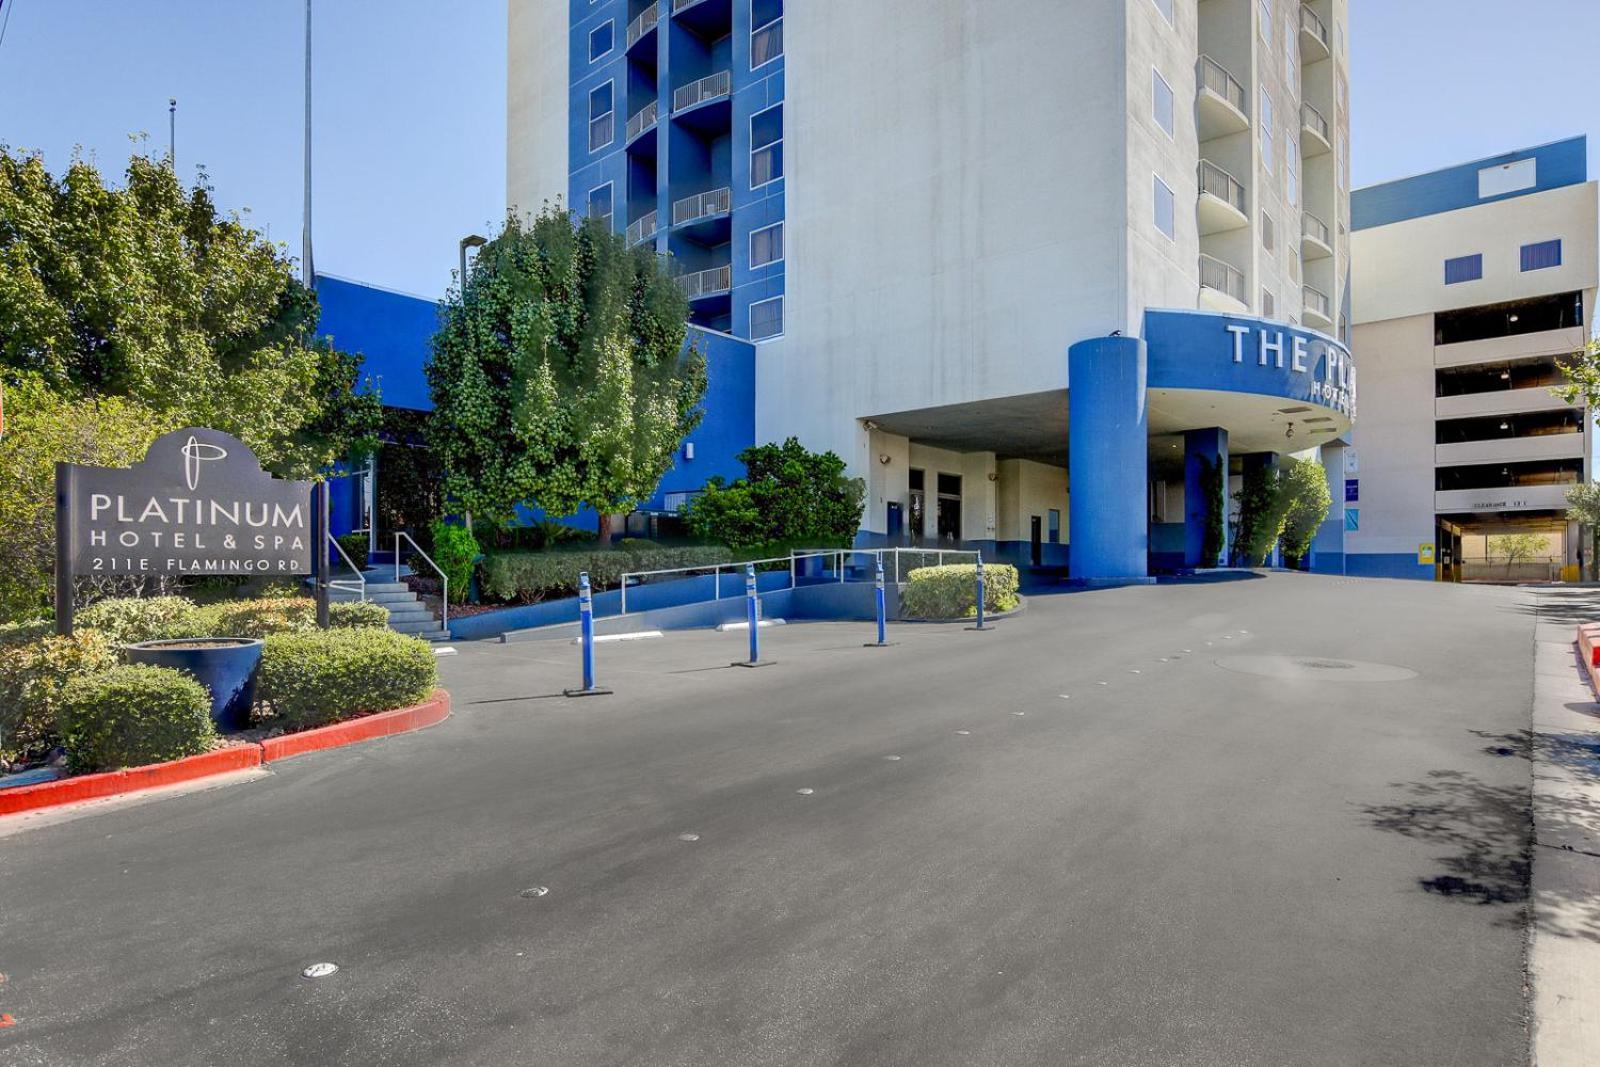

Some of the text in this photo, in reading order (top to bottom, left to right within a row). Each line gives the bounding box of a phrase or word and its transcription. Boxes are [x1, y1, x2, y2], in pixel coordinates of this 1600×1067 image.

[1227, 325, 1307, 372] THE
[90, 493, 304, 529] PLATINUM
[90, 530, 304, 551] HOTEL & SPA
[166, 559, 270, 571] FLAMINGO
